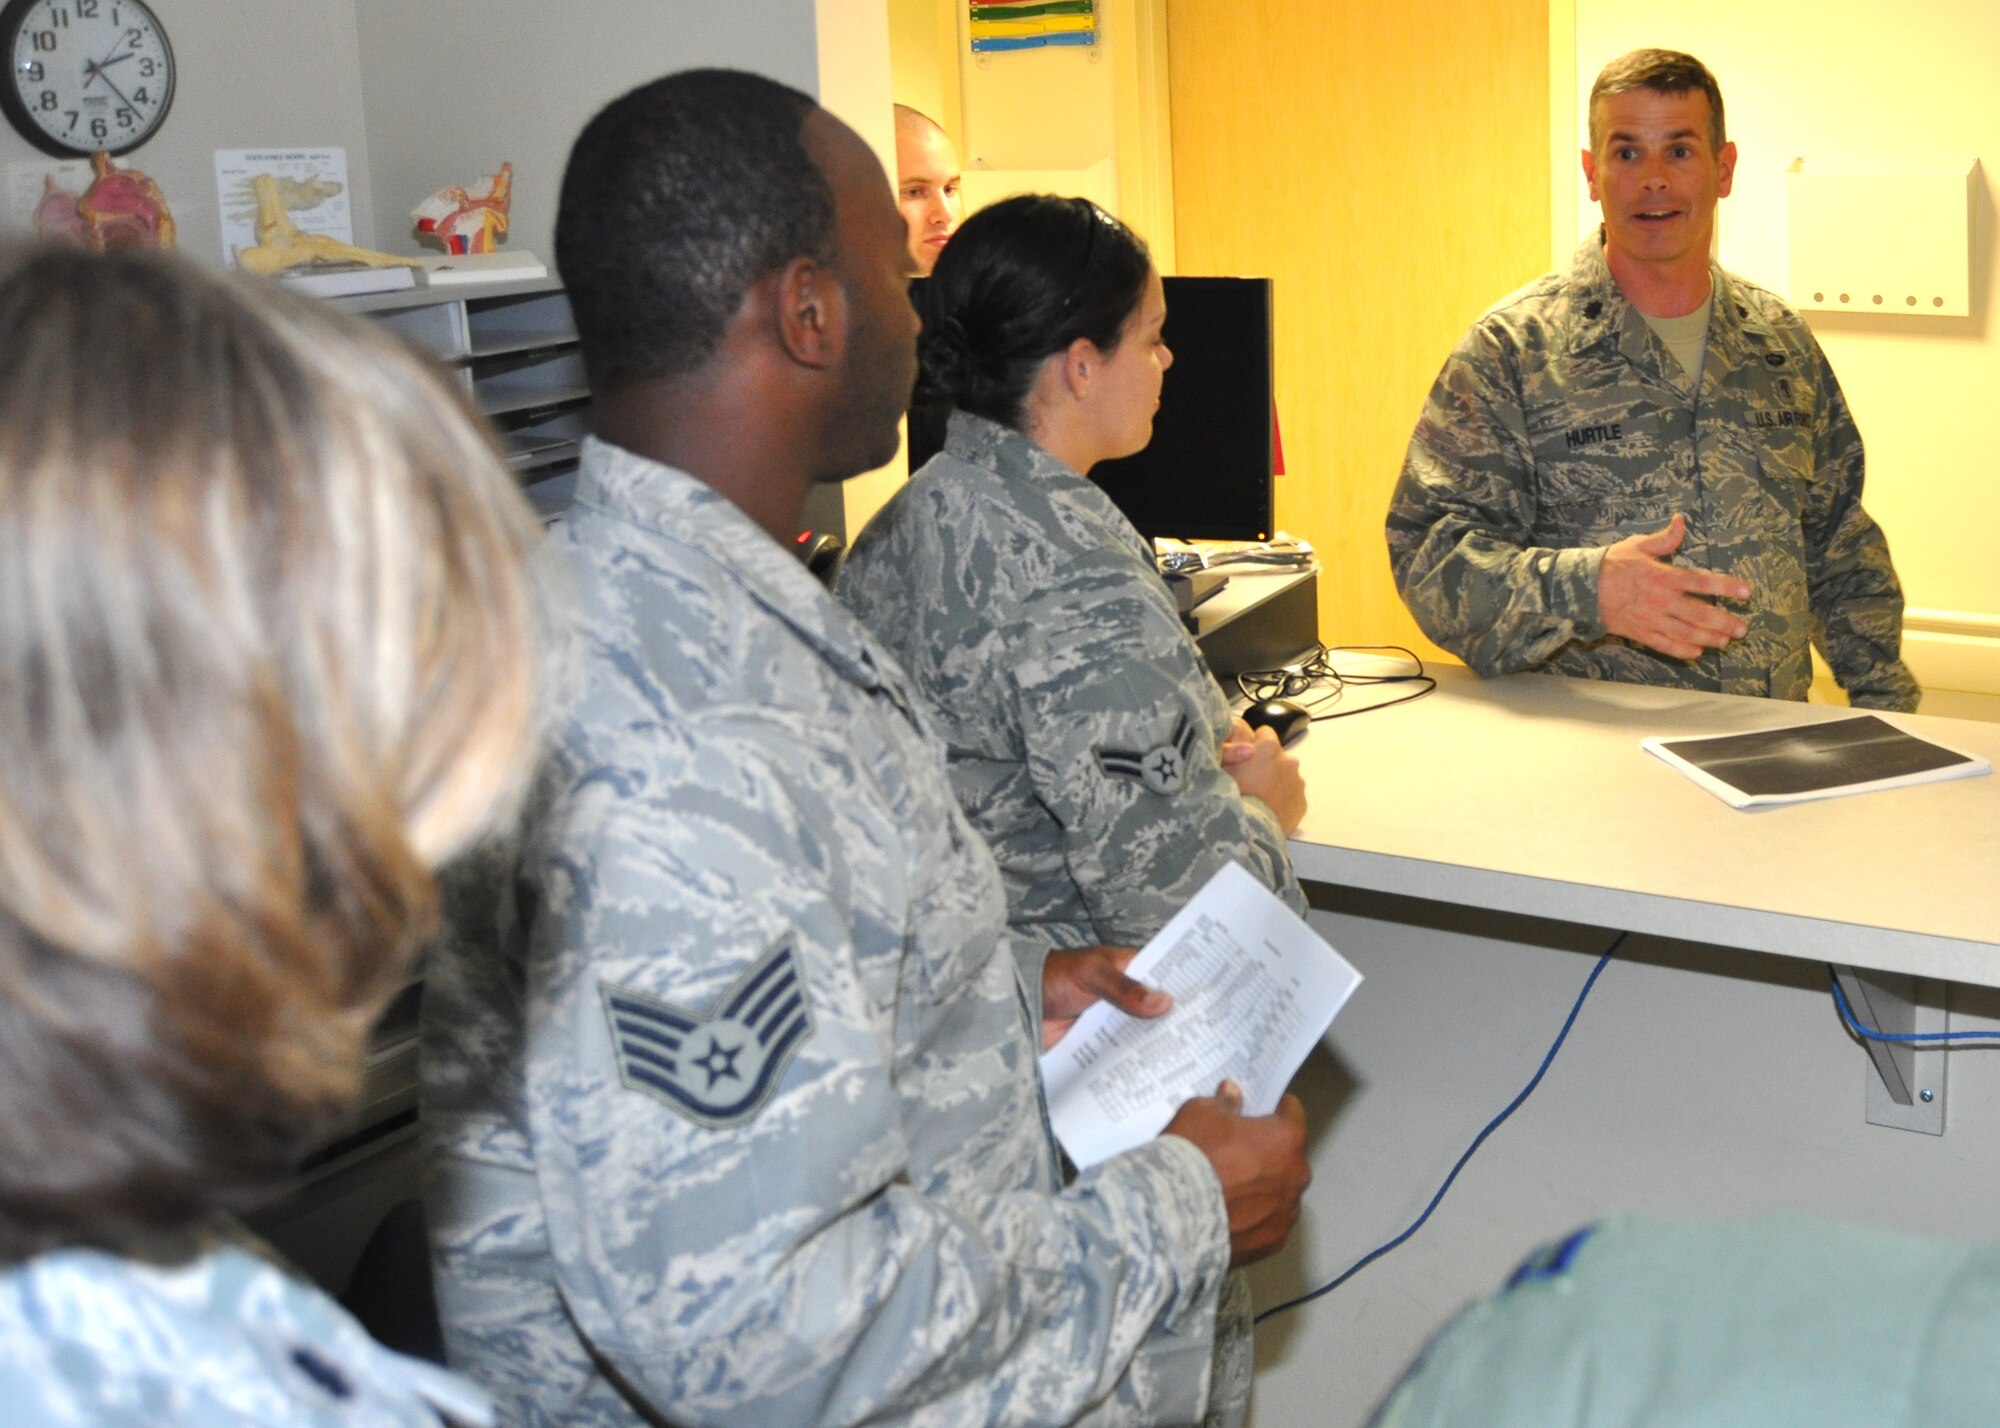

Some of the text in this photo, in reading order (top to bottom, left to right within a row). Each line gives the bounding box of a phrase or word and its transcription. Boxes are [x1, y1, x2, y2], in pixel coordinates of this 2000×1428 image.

[52, 8, 69, 28] 11
[76, 0, 99, 18] 12
[112, 7, 120, 26] 1
[32, 31, 57, 51] 10
[127, 28, 143, 48] 2
[28, 61, 45, 82] 9
[139, 57, 155, 77] 3
[40, 90, 58, 111] 8
[133, 87, 149, 105] 4
[64, 110, 79, 131] 7
[115, 108, 133, 127] 5
[90, 118, 108, 138] 6
[1755, 411, 1775, 428] U.S.
[1777, 410, 1795, 426] AIR
[1565, 424, 1622, 448] HURTLE
